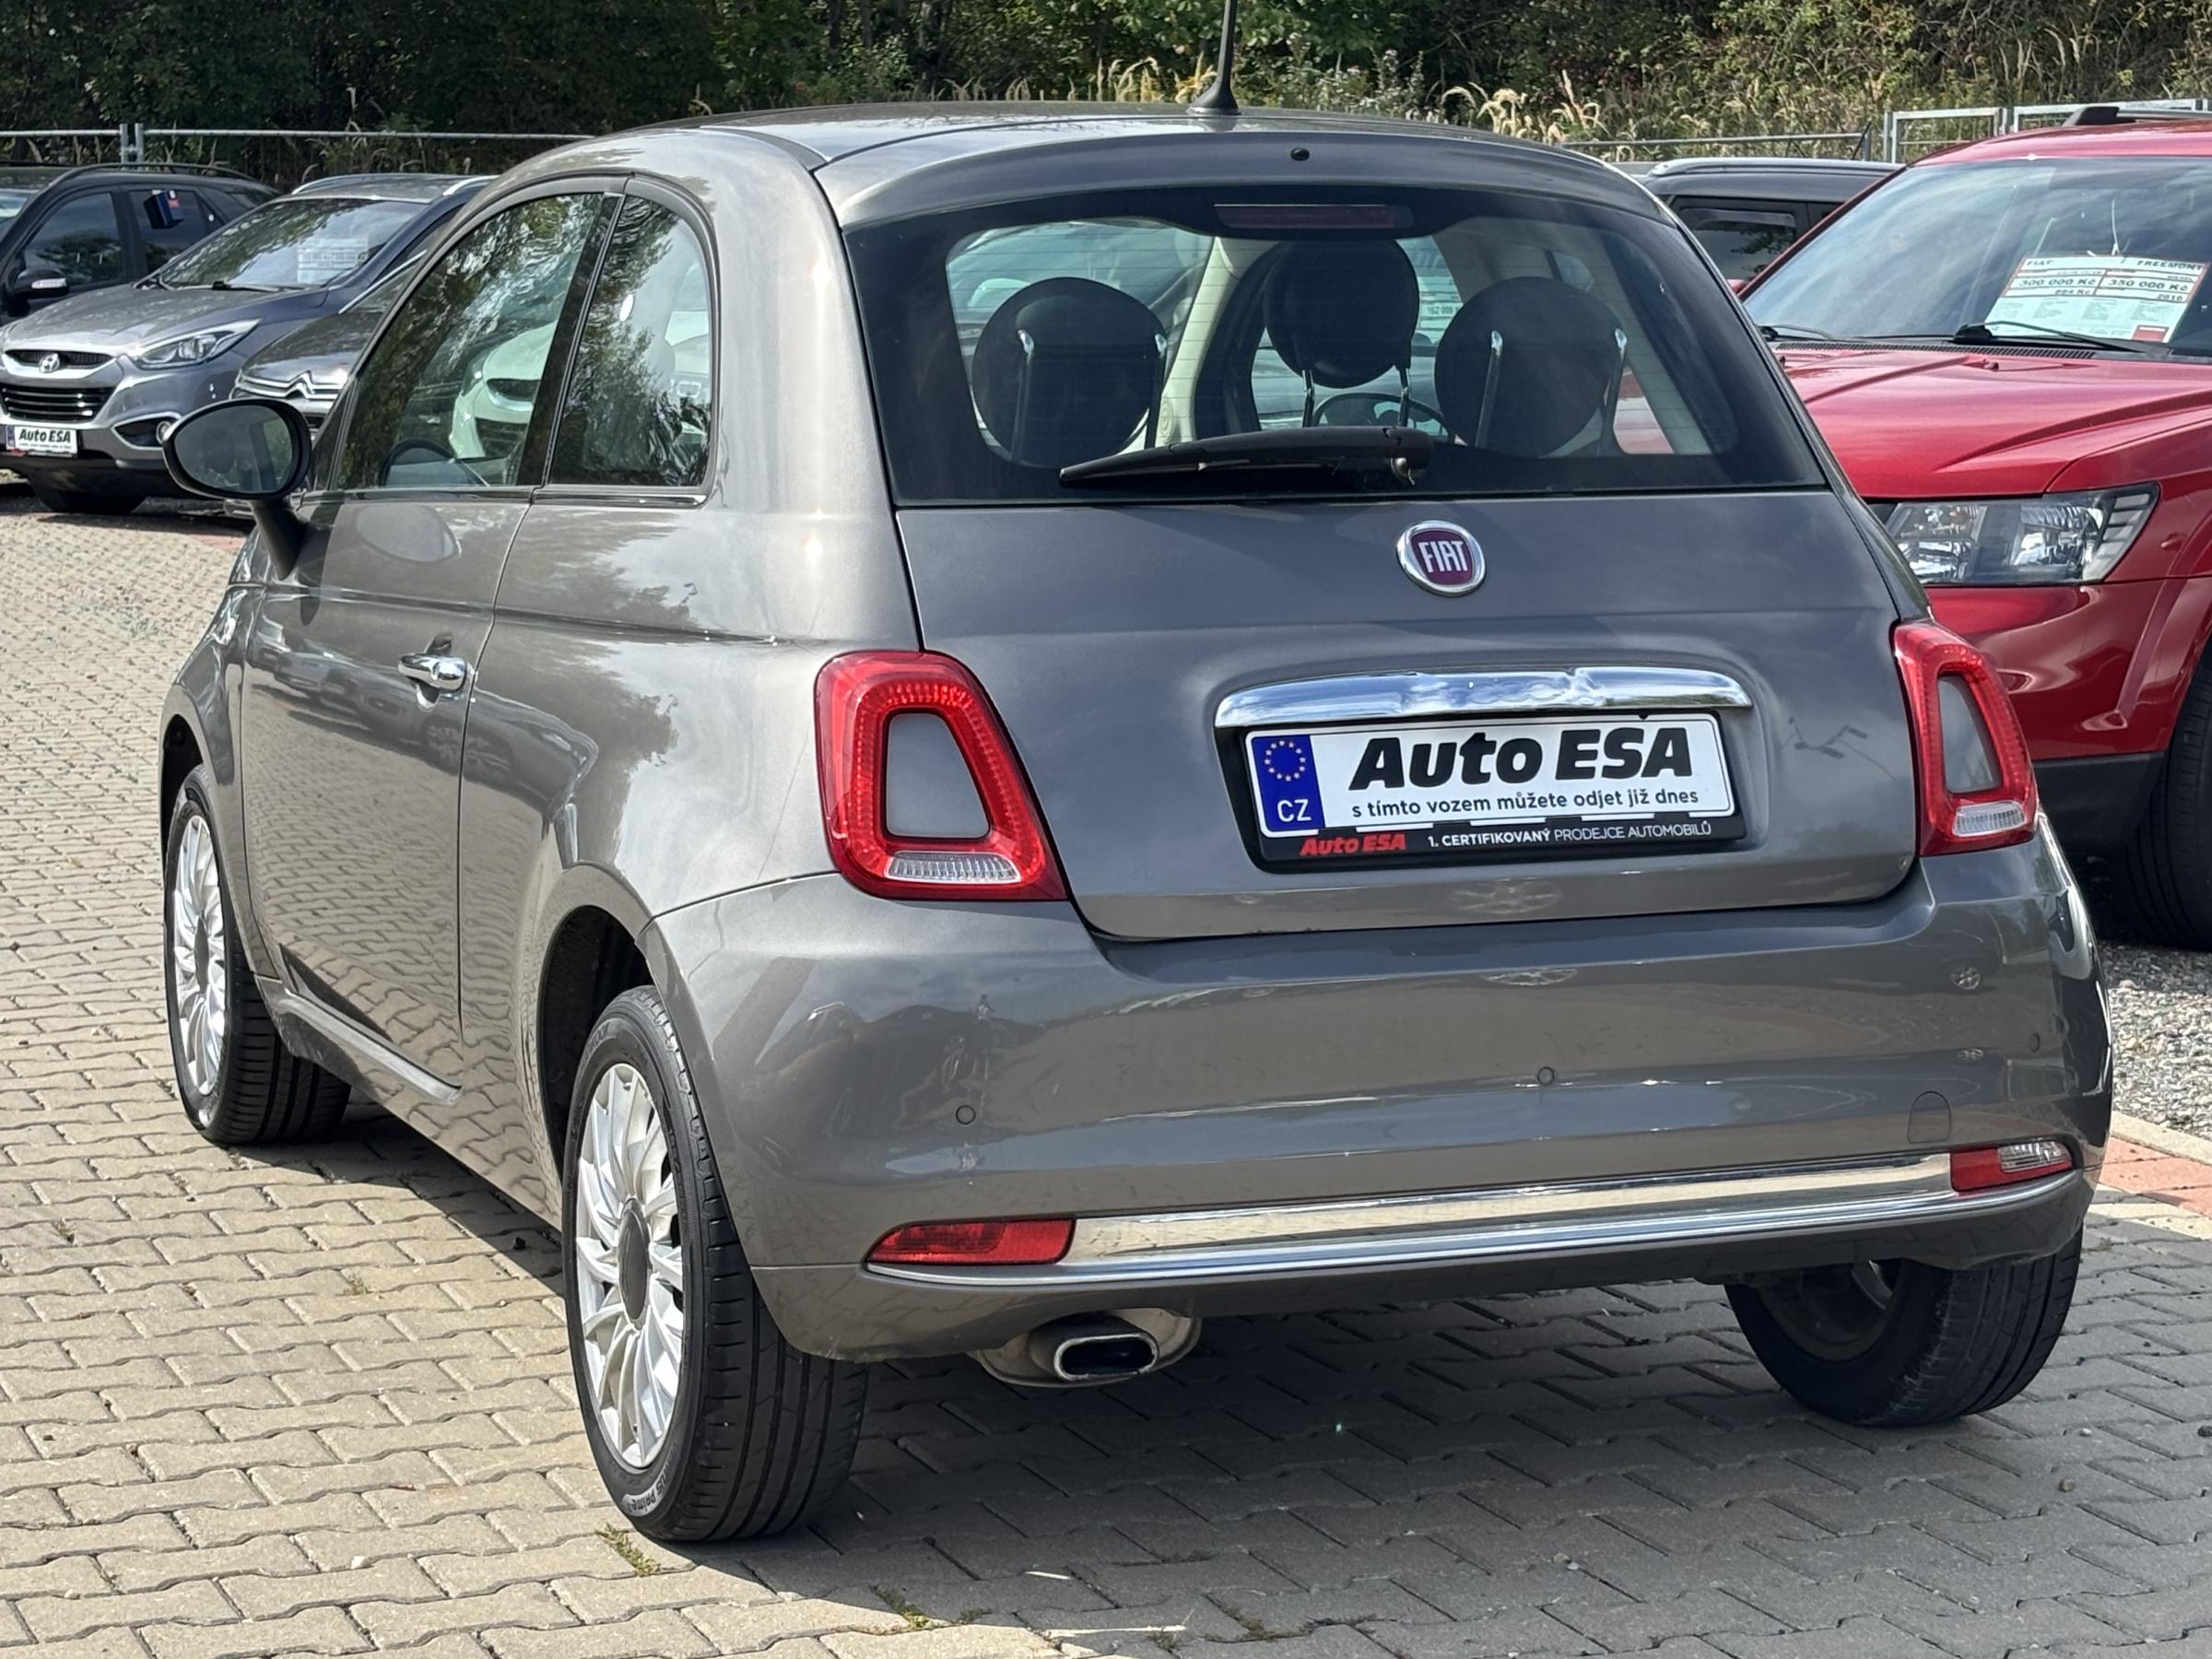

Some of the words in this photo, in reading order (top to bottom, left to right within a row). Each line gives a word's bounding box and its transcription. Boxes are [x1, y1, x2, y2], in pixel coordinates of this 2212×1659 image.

[2108, 278, 2136, 288] 350
[2138, 280, 2166, 290] 000
[18, 428, 47, 442] Auto
[48, 429, 72, 443] ESA
[1418, 540, 1469, 573] FIAT
[1347, 732, 1543, 791] Auto
[1555, 726, 1693, 781] ESA
[1277, 798, 1312, 823] CZ
[1352, 806, 1362, 818] s
[1368, 800, 1421, 818] tímto
[1427, 798, 1491, 814] vozem
[1497, 791, 1568, 811] můžete
[1573, 790, 1623, 809] odjet
[1628, 788, 1650, 808] již
[1655, 788, 1700, 805] dnes
[1299, 835, 1359, 856] Auto
[1362, 832, 1406, 853] ESA
[1428, 835, 1440, 848] 1.
[1441, 828, 1551, 847] CERTIFIKOVANÝ
[1554, 826, 1626, 841] PRODEJCE
[1628, 820, 1712, 839] AUTOMOBILŮ
